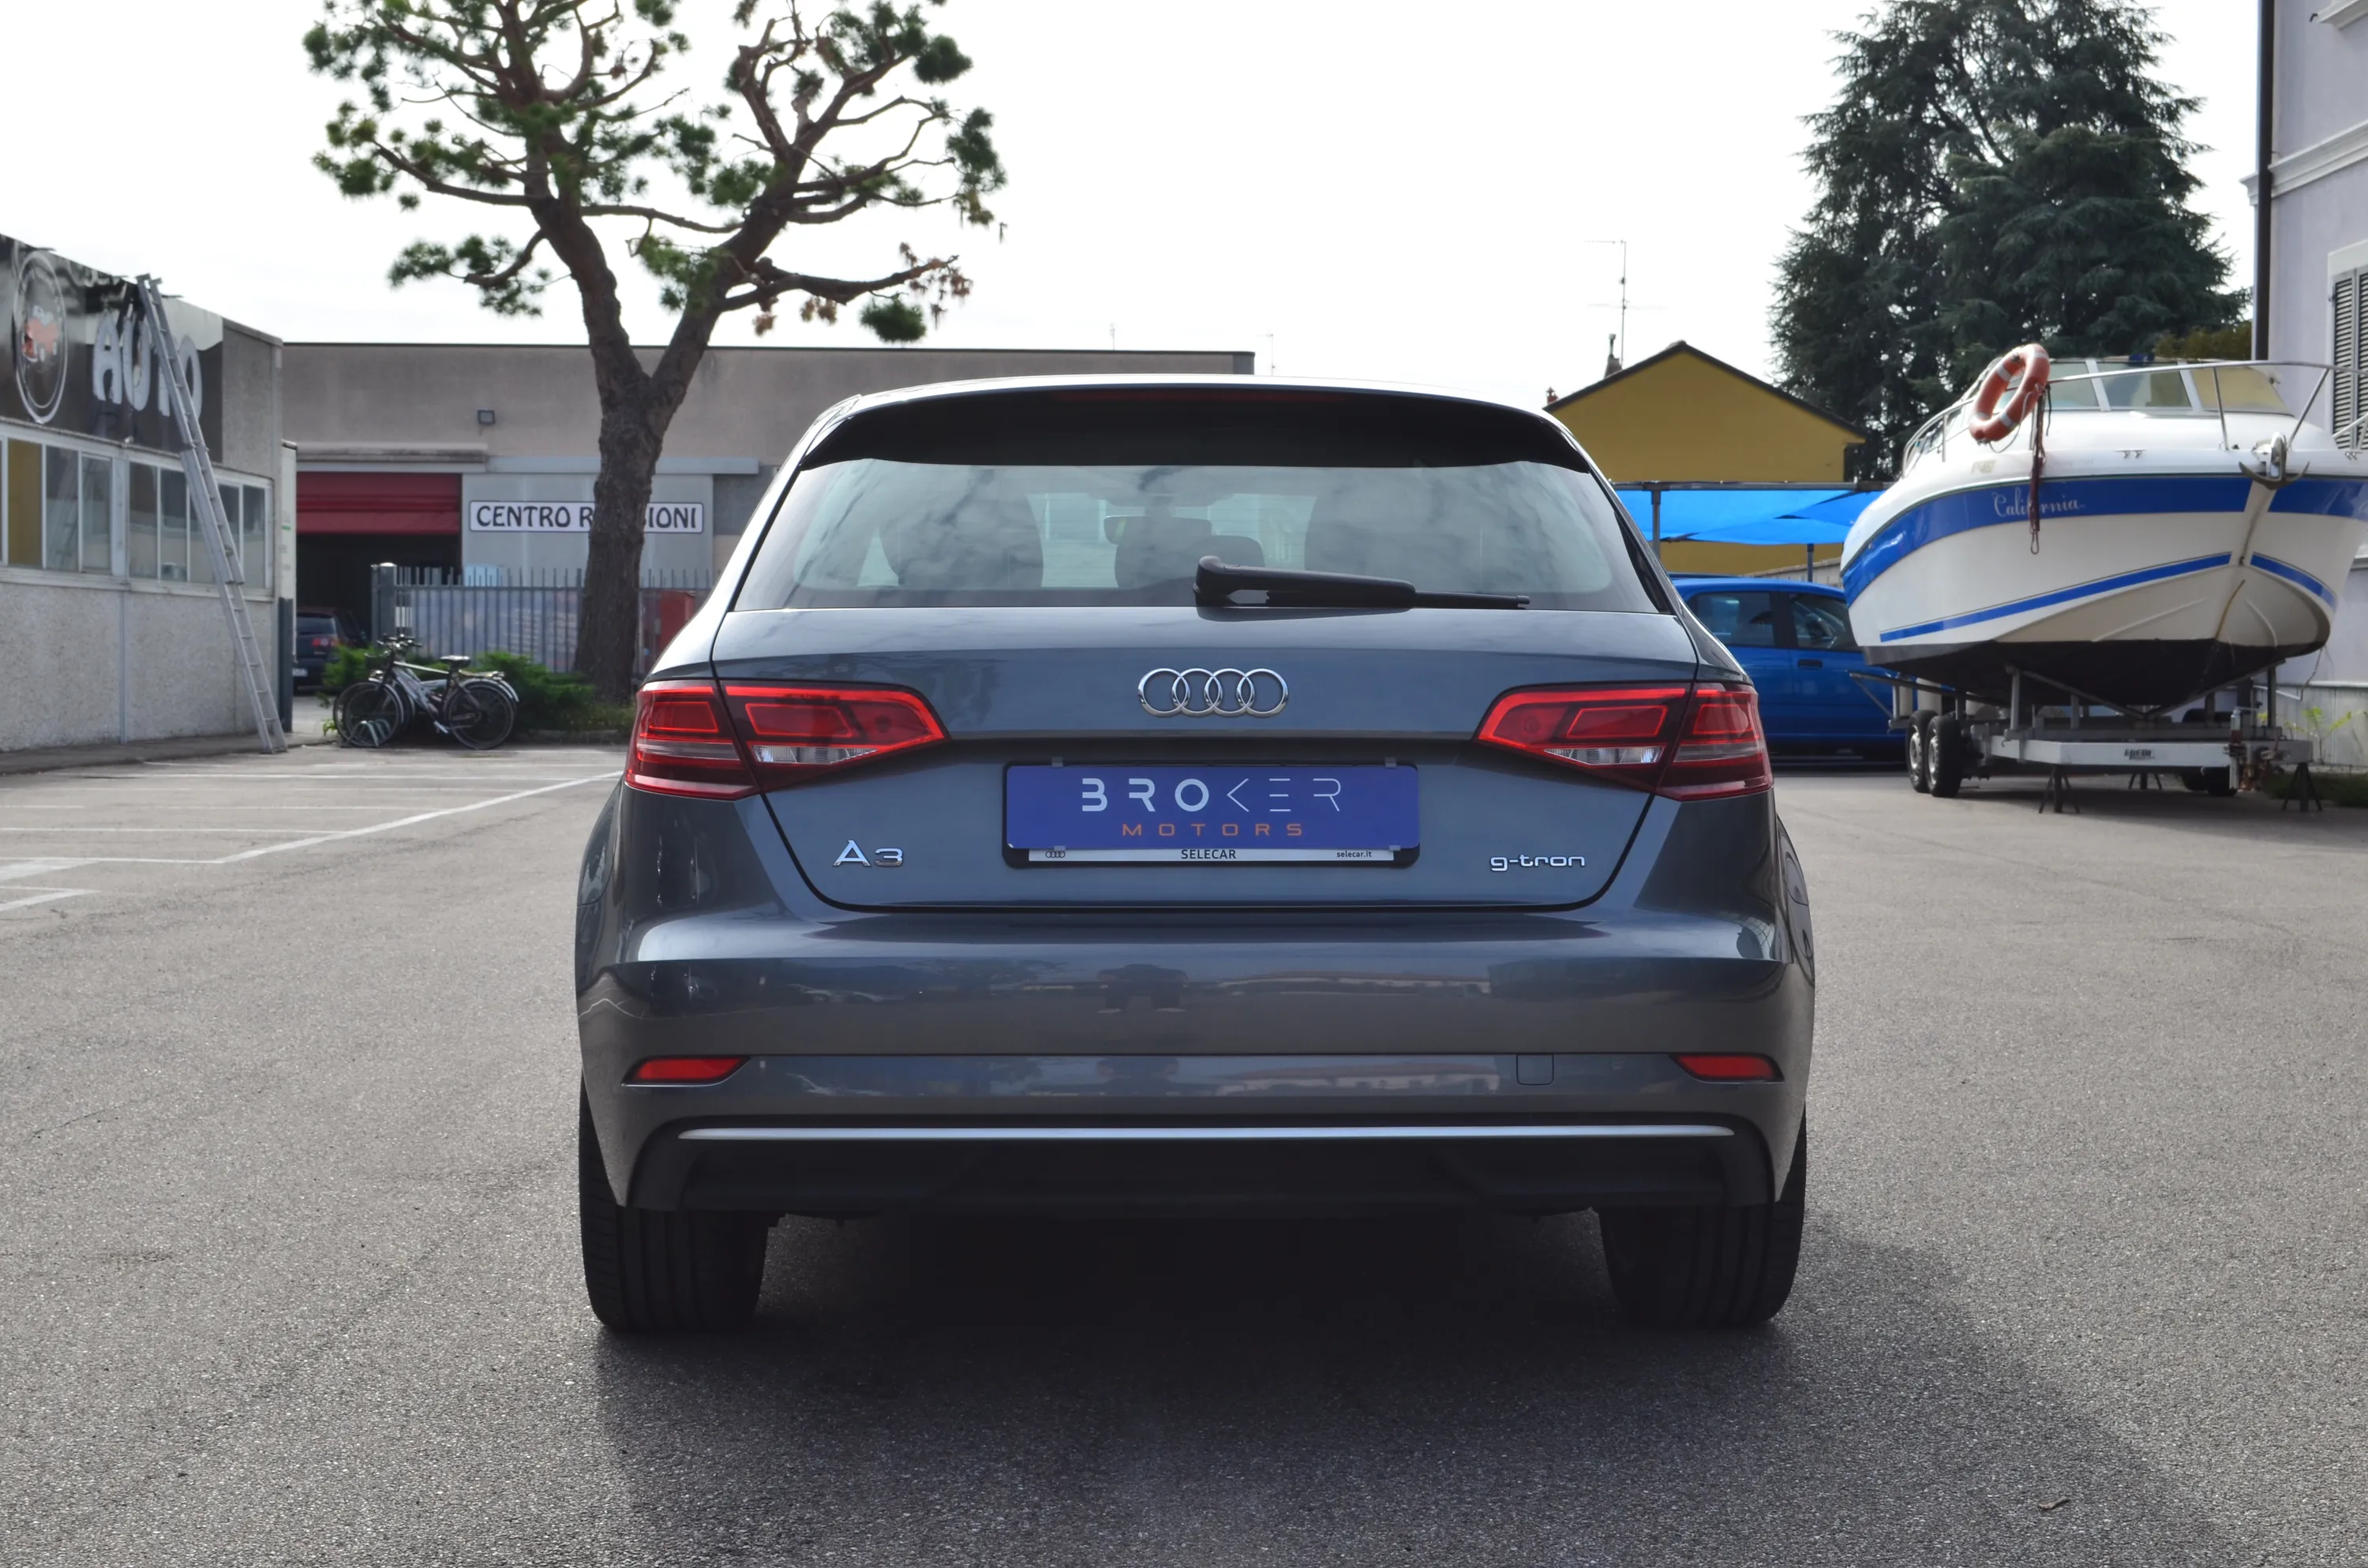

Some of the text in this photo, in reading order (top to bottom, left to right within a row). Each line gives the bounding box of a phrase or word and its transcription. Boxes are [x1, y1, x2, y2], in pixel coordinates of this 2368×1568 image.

[1991, 486, 2085, 518] Calirnia
[476, 505, 696, 529] CENTRO RIONI
[1081, 777, 1341, 812] BROKER
[1122, 823, 1302, 836] MOTORS
[833, 840, 903, 866] A3
[1181, 848, 1237, 859] SELECAR
[1489, 854, 1586, 872] g-tron
